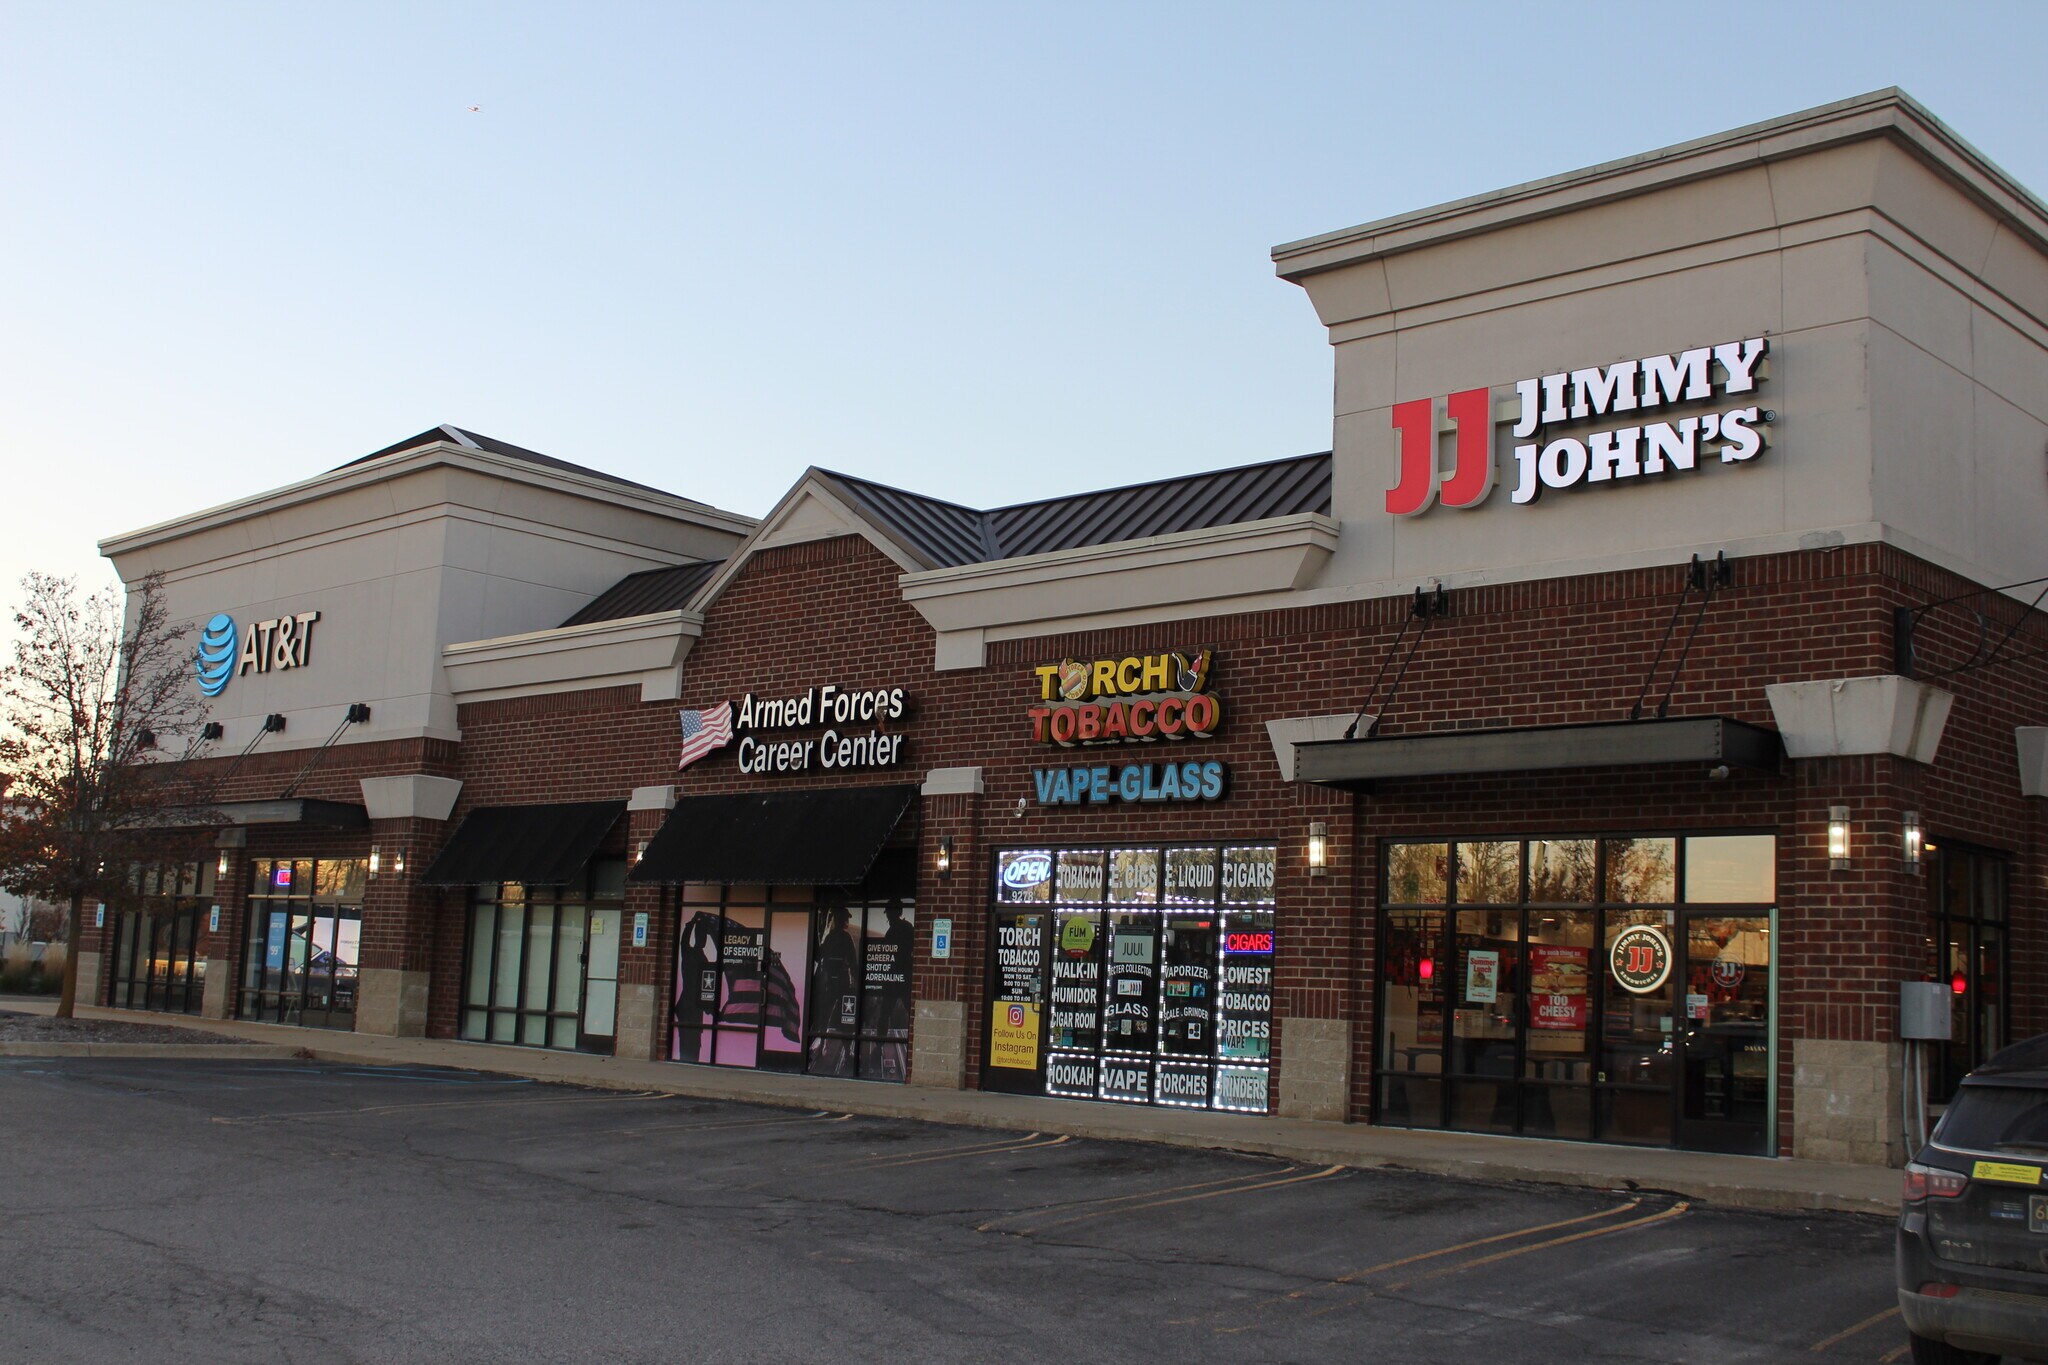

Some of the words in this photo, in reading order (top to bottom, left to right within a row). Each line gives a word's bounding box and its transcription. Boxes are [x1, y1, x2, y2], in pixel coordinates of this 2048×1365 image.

[1513, 338, 1766, 438] JIMMY
[1386, 387, 1493, 516] JJ
[1511, 406, 1763, 505] JOHN'S
[238, 611, 320, 676] AT&T
[737, 688, 814, 729] Armed
[820, 686, 904, 723] Forces
[1028, 695, 1213, 742] TOBACCO
[738, 737, 814, 773] Career
[821, 730, 902, 768] Center
[1034, 761, 1224, 805] VAPE-GLASS
[1007, 861, 1050, 881] OPEN
[1060, 865, 1103, 889] TOBACCO
[1125, 864, 1157, 889] CIGS
[1178, 864, 1215, 889] LIQUID
[1223, 862, 1275, 888] CIGARS
[1011, 890, 1034, 902] 9278
[724, 935, 751, 945] LEGACY
[999, 927, 1041, 947] TORCH
[1070, 925, 1086, 938] FÜM
[867, 944, 880, 952] GIVE
[881, 944, 898, 953] YOUR
[1122, 943, 1144, 957] JUUL
[1227, 933, 1271, 951] CIGARS
[1617, 933, 1641, 955] JIMMY
[1641, 933, 1664, 957] JOHN'S
[723, 946, 733, 956] OF
[733, 947, 762, 957] SERVIC
[866, 954, 890, 962] CAREER
[998, 949, 1040, 966] TOBACCO
[1626, 945, 1654, 973] JJ
[866, 963, 882, 971] SHOT
[1053, 962, 1098, 979] WALK-IN
[1125, 964, 1152, 978] COLLECTOR
[1470, 958, 1497, 967] Summer
[1473, 965, 1492, 974] Lunch
[865, 973, 905, 982] ADRENALINE.
[1164, 965, 1209, 980] VAPORIZER
[1221, 966, 1271, 985] LOWEST
[1052, 987, 1097, 1004] HUMIDOR
[1220, 992, 1271, 1011] TOBACCO
[1548, 995, 1569, 1006] TOO
[1107, 1002, 1149, 1018] GLASS
[1163, 1007, 1180, 1021] SCALE
[1183, 1006, 1209, 1021] GRINDER
[1539, 1006, 1577, 1018] CHEESY
[1051, 1011, 1073, 1028] CIGAR
[1074, 1013, 1096, 1029] ROOM
[1220, 1019, 1270, 1038] PRICES
[994, 1028, 1014, 1039] Follow
[1016, 1029, 1026, 1039] Us
[1027, 1030, 1037, 1040] On
[1226, 1035, 1245, 1049] VAPE
[994, 1041, 1034, 1055] Instagram
[996, 1057, 1032, 1066] @torchtobacco
[1048, 1064, 1094, 1086] HOOKAH
[1103, 1068, 1148, 1091] VAPE
[1159, 1072, 1208, 1096] TORCHES
[1216, 1074, 1267, 1100] GRINDERS
